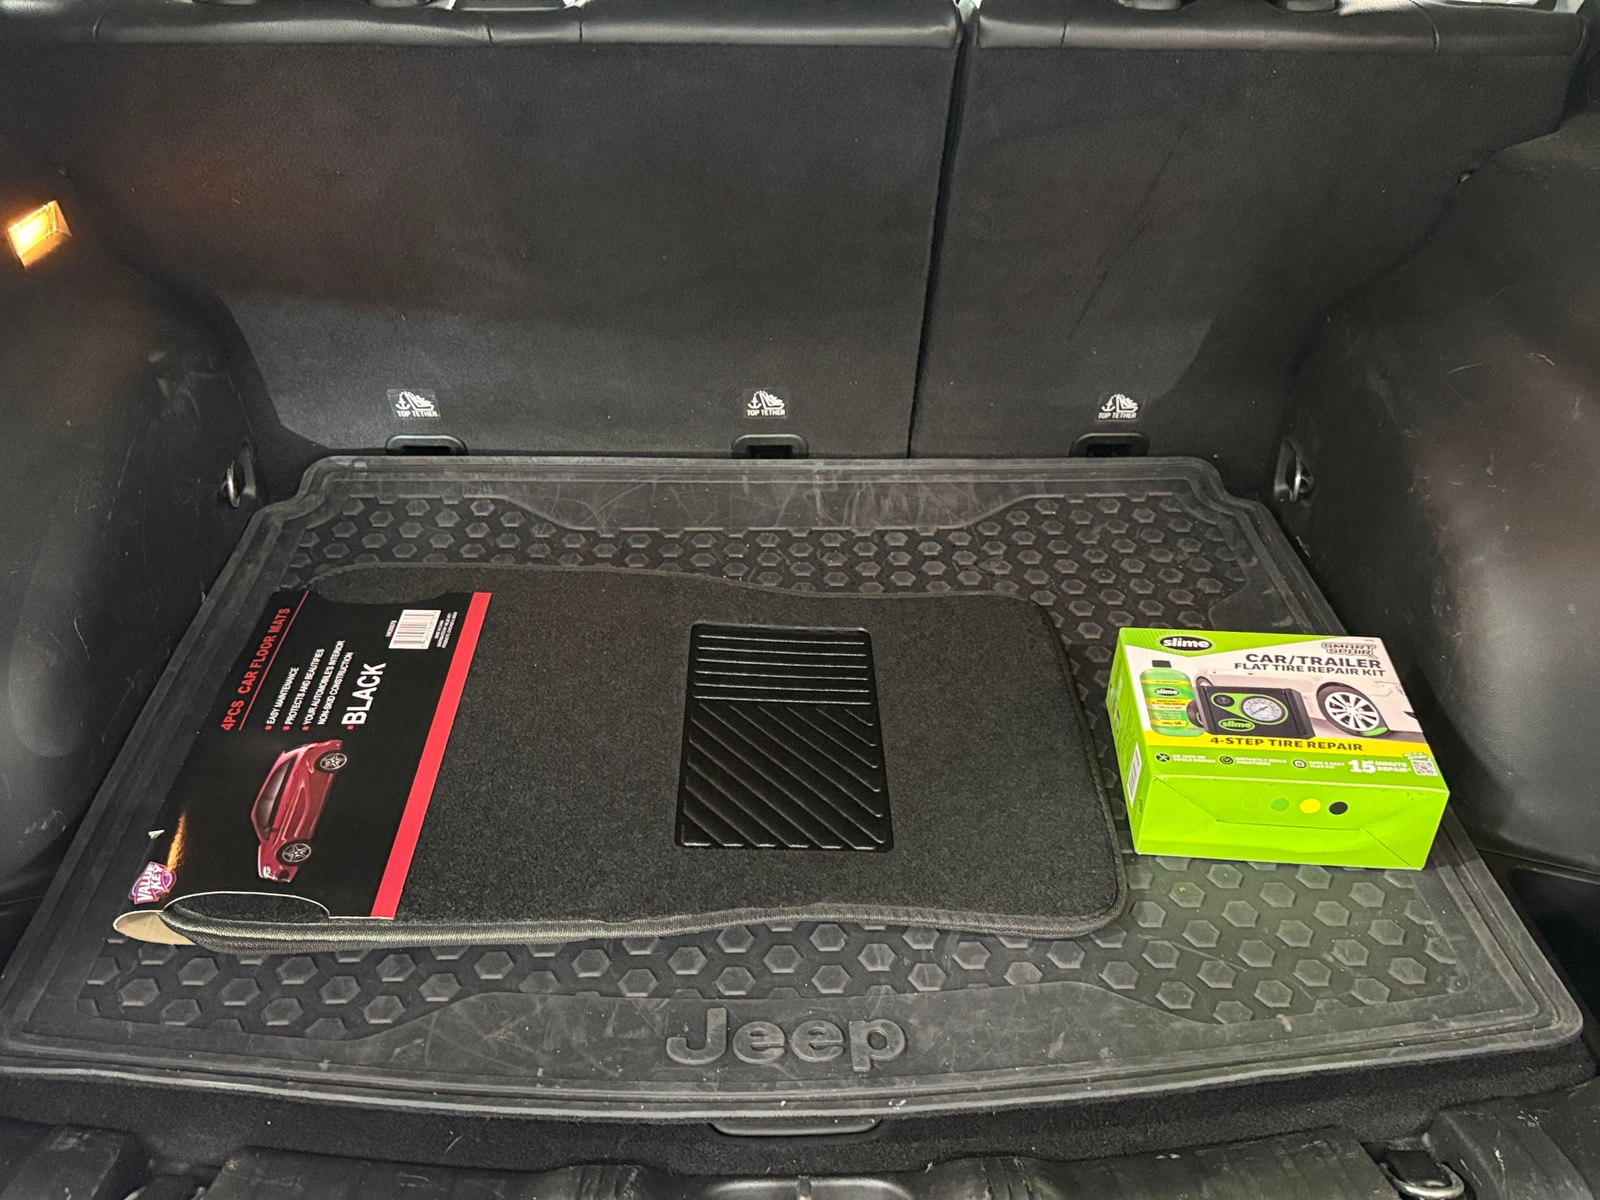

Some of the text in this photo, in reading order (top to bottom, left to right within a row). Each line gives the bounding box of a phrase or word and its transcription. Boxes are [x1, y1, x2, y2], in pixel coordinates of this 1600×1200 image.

[1163, 638, 1210, 648] slime
[1245, 653, 1382, 669] CAR/TRAILER
[221, 607, 291, 731] 4PCS CAR FLOOR MATS
[303, 707, 316, 725] YOUR
[328, 640, 346, 666] INTERIOR
[317, 652, 354, 725] NON-SKID CONSTRUCTION
[1234, 662, 1386, 677] FLAT TIRE REPAIR KIT
[266, 667, 299, 725] EASY MAINTENANCE
[284, 693, 305, 725] PROTECTS
[299, 680, 311, 694] AND
[341, 663, 387, 725] BLACK
[1210, 737, 1363, 751] 4-STEP TIRE REPAIR
[1222, 720, 1251, 729] slime
[1348, 759, 1376, 774] 15
[136, 862, 165, 901] VALUE KEY
[666, 1007, 906, 1072] Jeep
